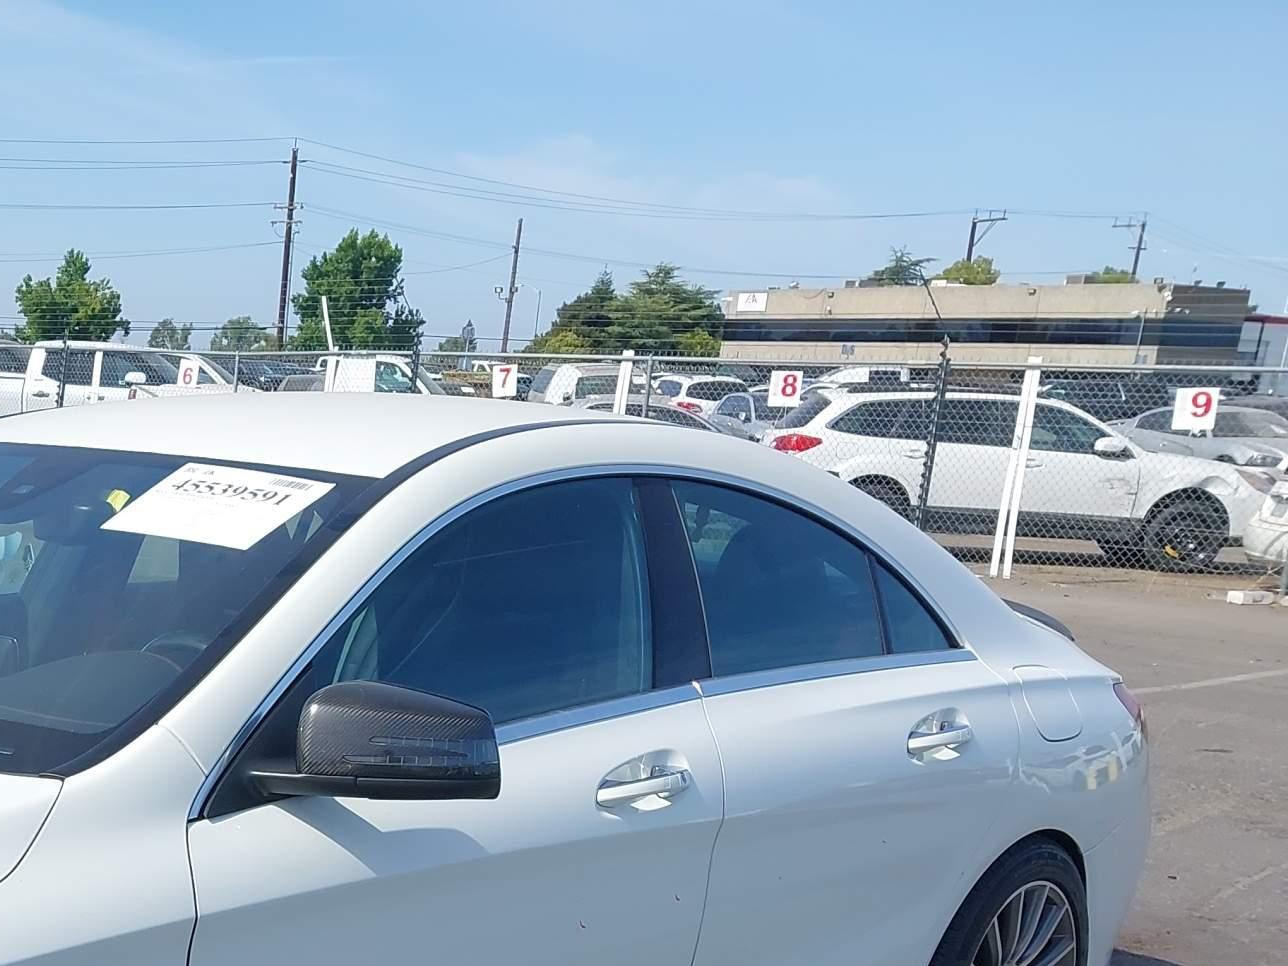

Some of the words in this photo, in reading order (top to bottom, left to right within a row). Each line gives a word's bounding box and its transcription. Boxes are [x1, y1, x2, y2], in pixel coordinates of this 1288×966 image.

[182, 367, 194, 385] 6
[499, 367, 512, 388] 7
[781, 374, 798, 397] 8
[1191, 391, 1212, 417] 9
[171, 479, 292, 506] 45539591
